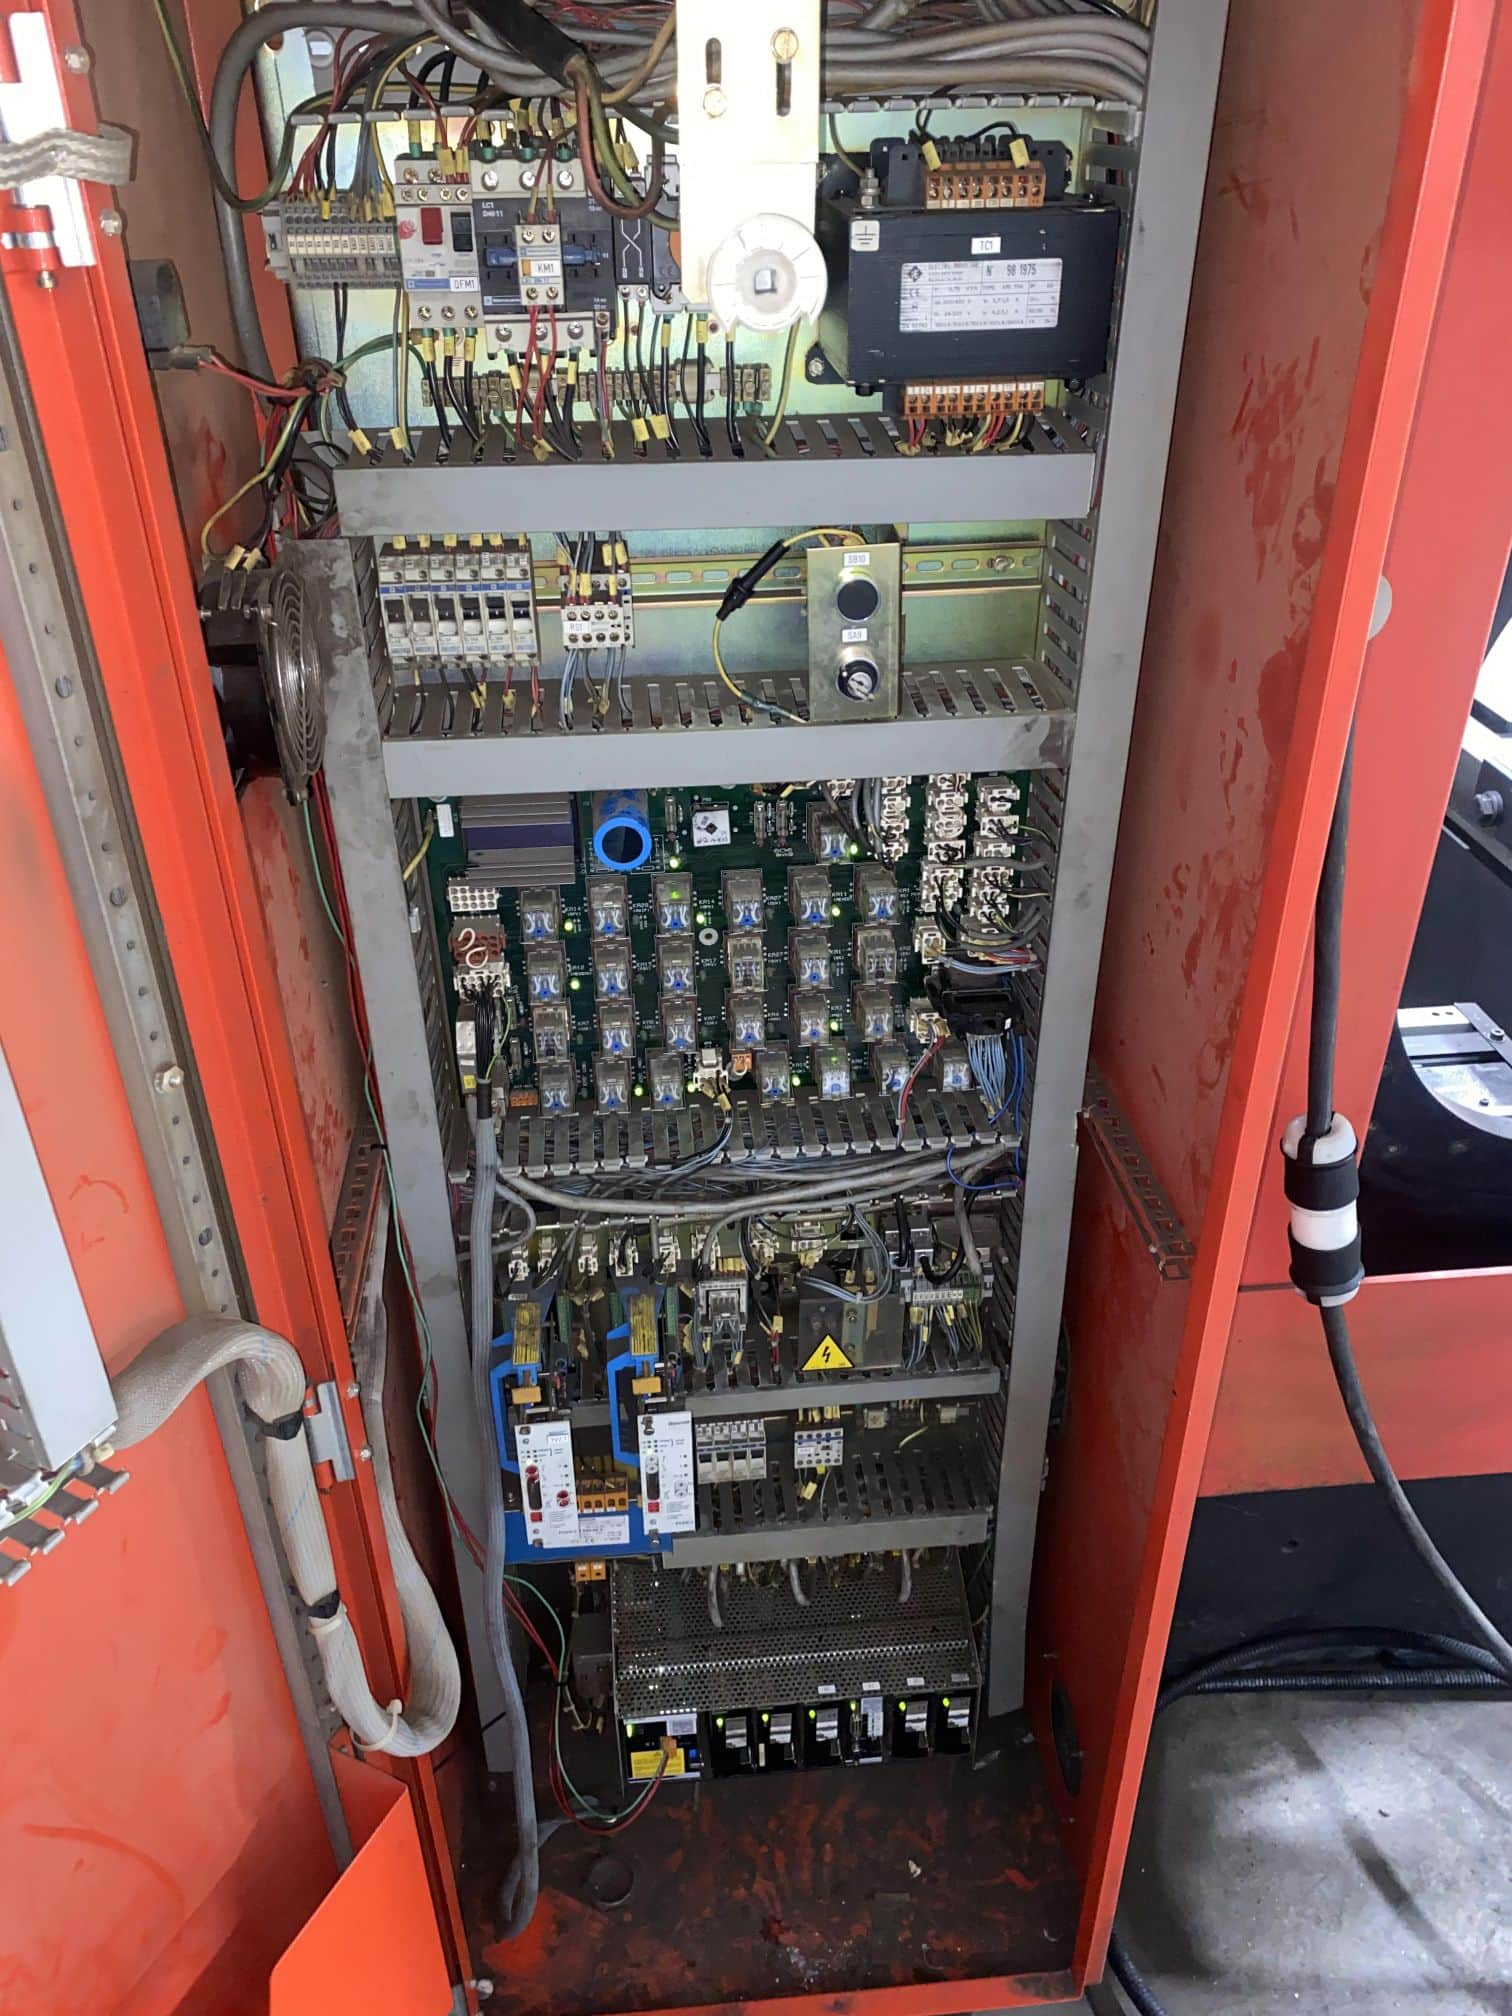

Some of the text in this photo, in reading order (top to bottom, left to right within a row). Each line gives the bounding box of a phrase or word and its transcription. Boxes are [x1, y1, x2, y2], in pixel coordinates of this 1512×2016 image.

[979, 240, 994, 251] TC1
[537, 263, 554, 273] KM1
[454, 279, 475, 289] QFM1
